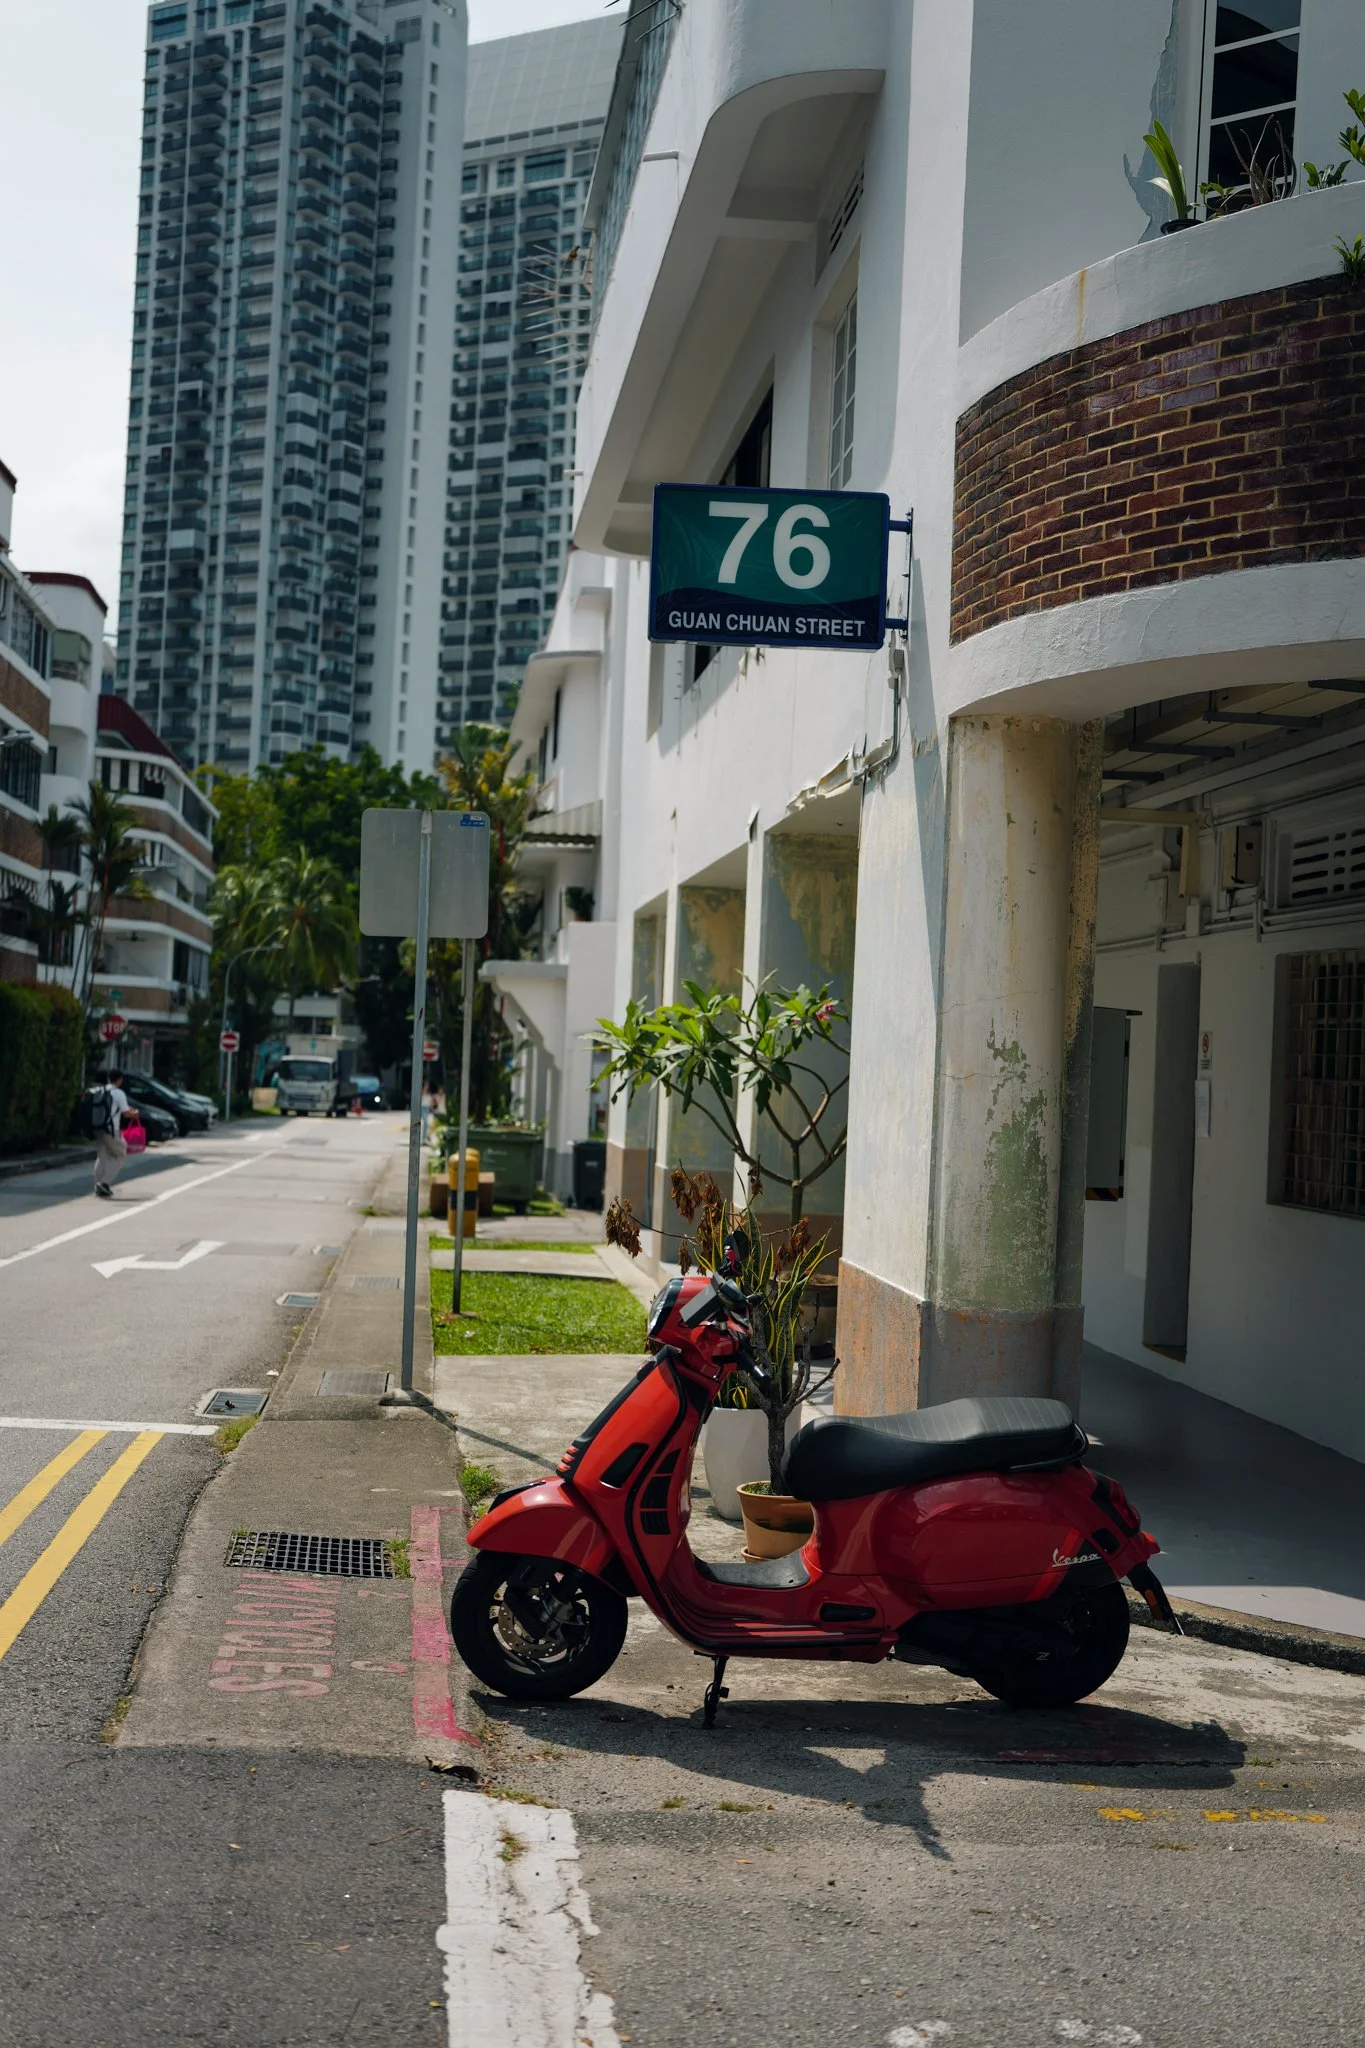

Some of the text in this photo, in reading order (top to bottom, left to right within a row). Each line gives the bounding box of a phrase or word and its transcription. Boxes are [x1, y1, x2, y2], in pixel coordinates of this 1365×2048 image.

[708, 501, 831, 590] 76
[668, 610, 866, 637] GUAN CHUAN STREET
[102, 1021, 126, 1034] STOP
[1051, 1548, 1102, 1567] Vespa
